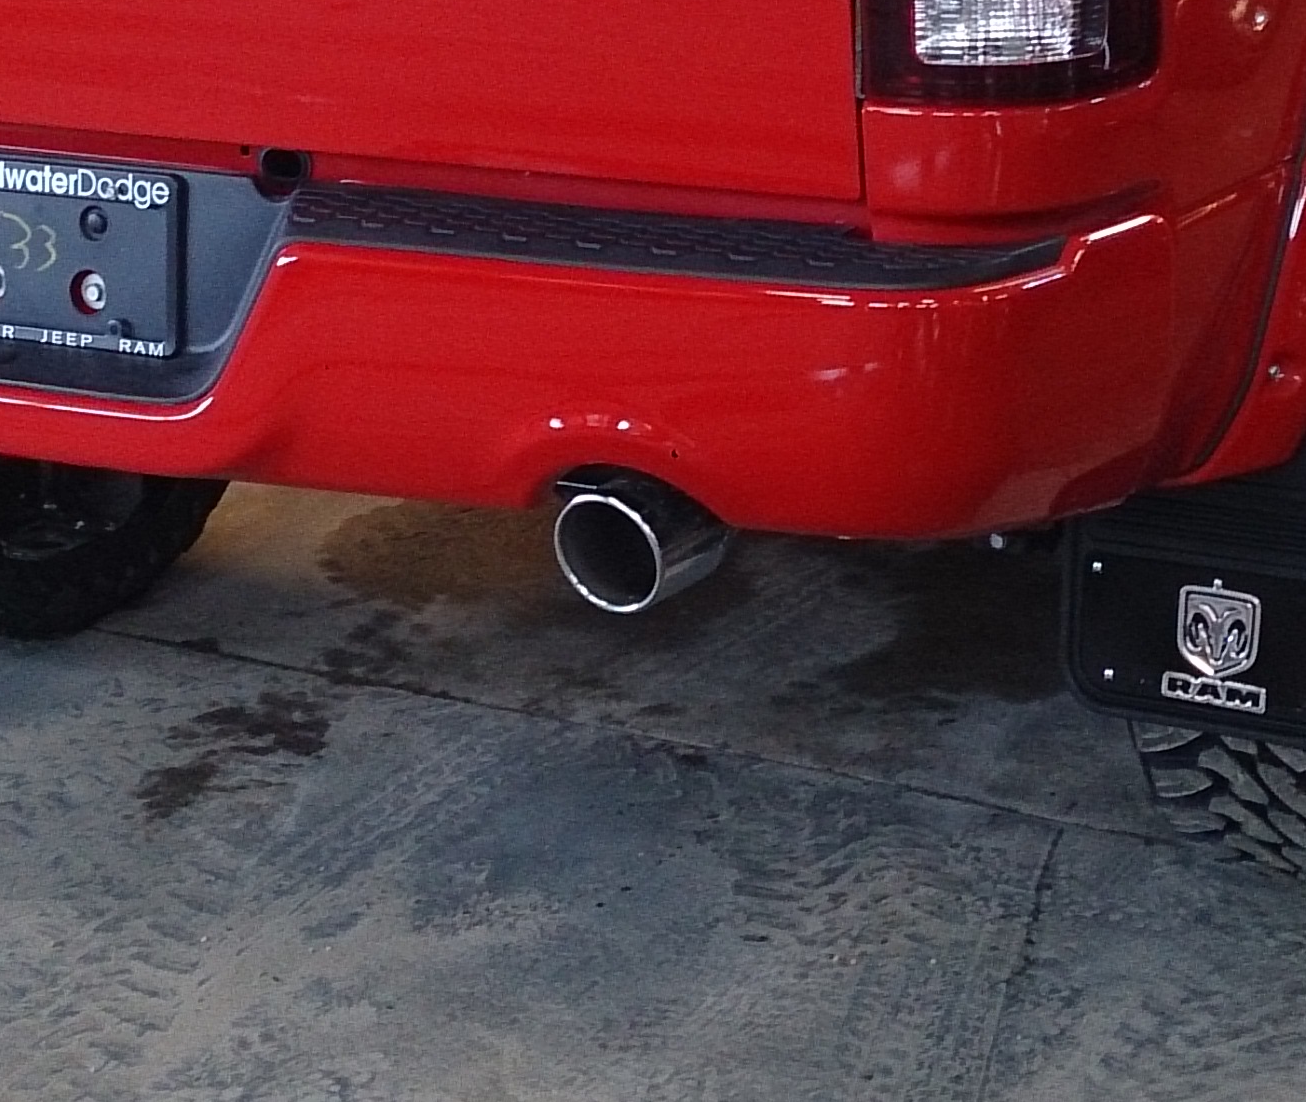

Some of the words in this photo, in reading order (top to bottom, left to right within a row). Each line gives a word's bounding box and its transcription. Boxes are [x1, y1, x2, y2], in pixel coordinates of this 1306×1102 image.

[39, 329, 93, 348] JEEP
[118, 338, 165, 357] RAM
[1161, 671, 1267, 715] RAM
